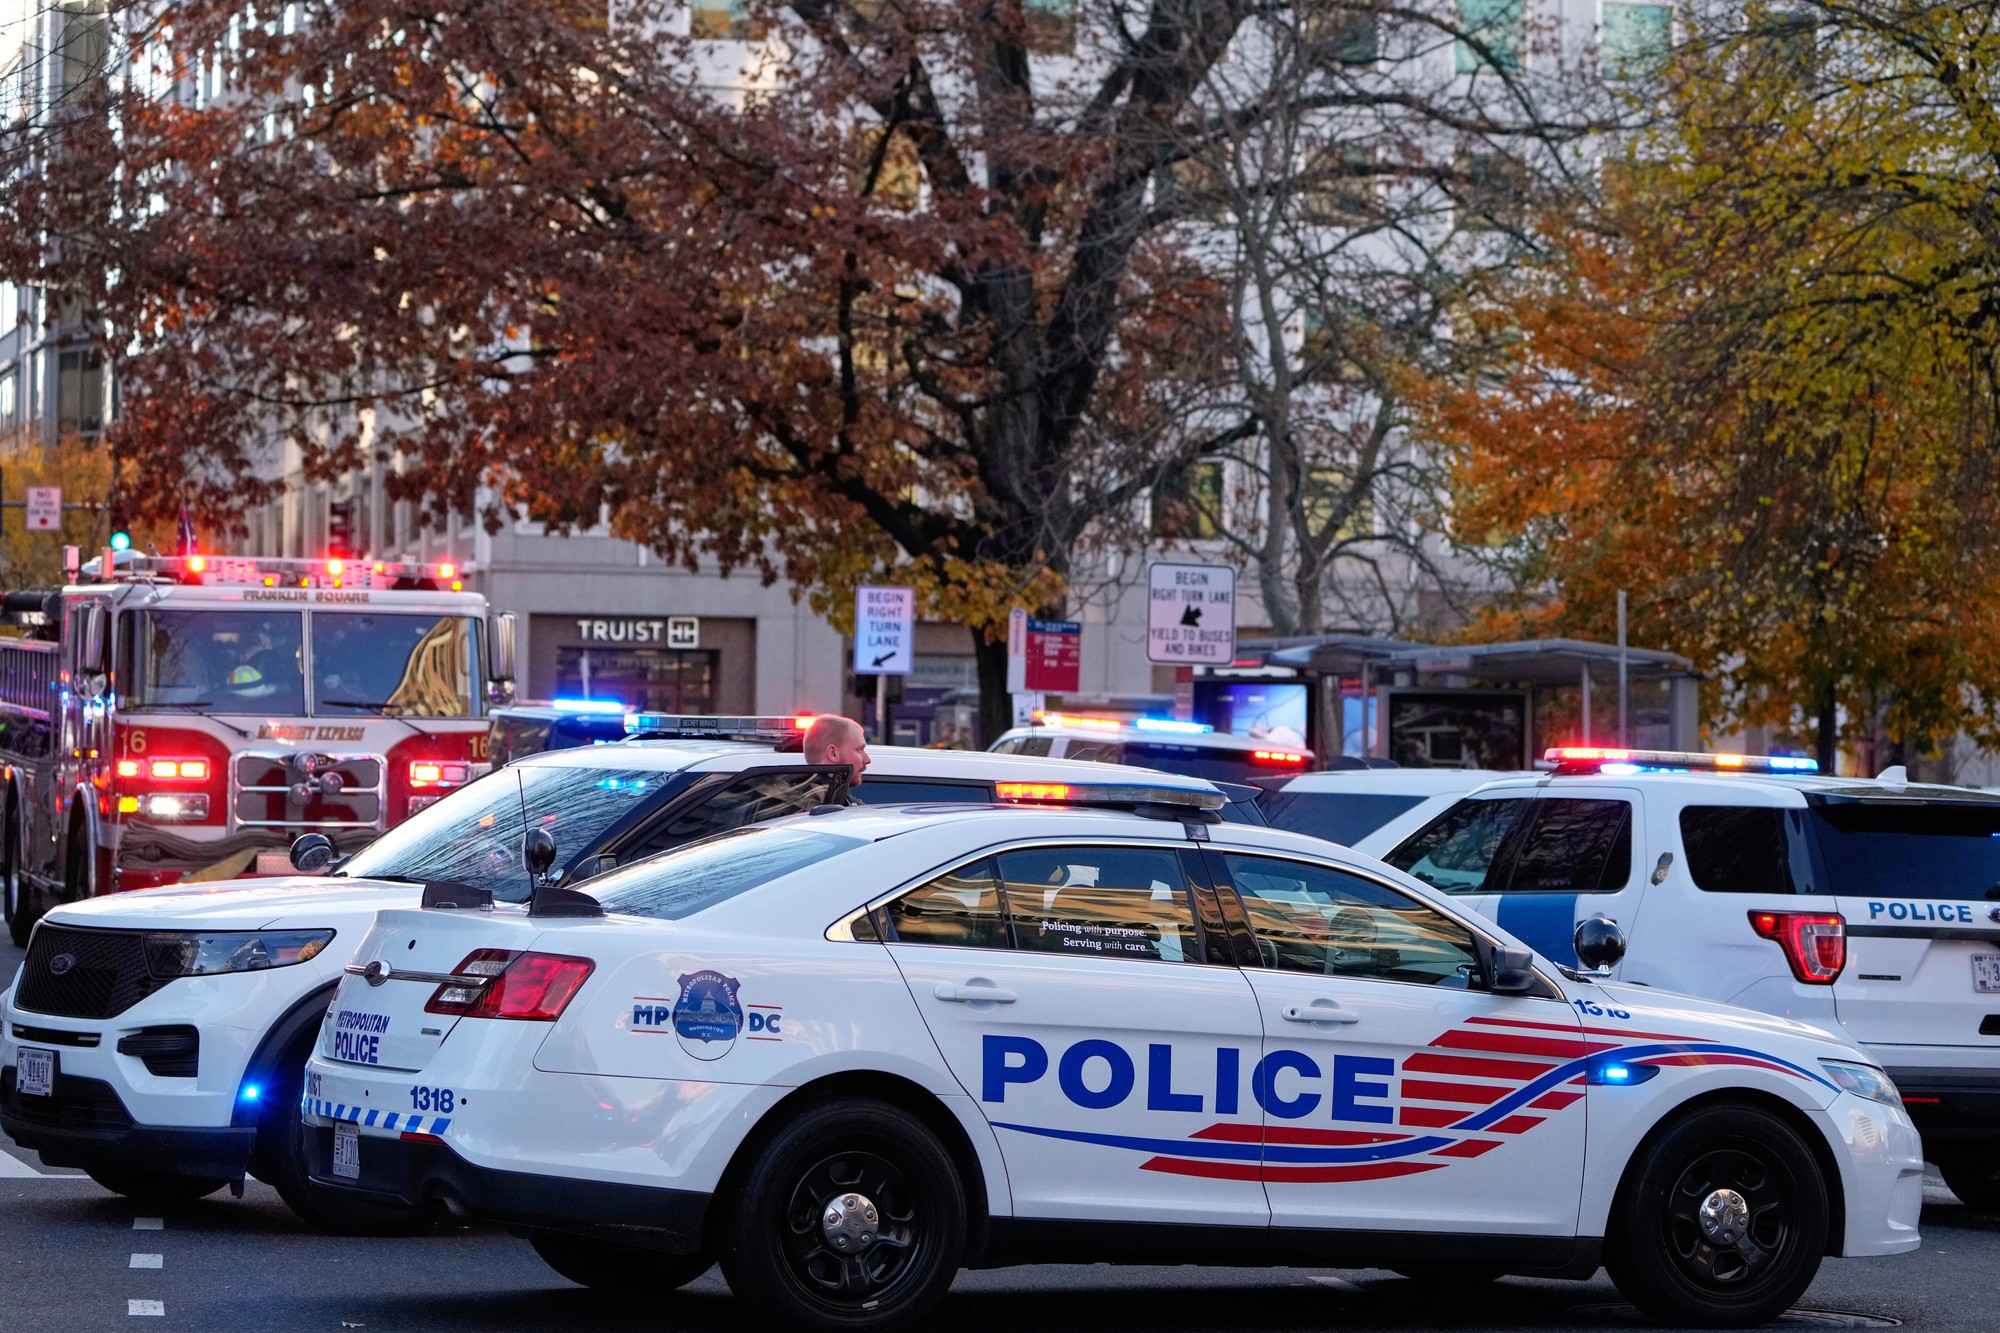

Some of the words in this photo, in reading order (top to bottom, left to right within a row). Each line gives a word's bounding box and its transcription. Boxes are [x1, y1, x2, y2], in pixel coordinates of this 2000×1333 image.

[1175, 571, 1209, 585] BEGIN
[243, 590, 308, 601] FRANKLIN
[315, 592, 370, 603] SQUARE
[867, 592, 904, 604] BEGIN
[1152, 588, 1179, 602] RIGHT
[1181, 589, 1205, 603] TURN
[1208, 590, 1231, 604] LANE
[867, 607, 902, 618] RIGHT
[577, 619, 665, 643] TRUIST
[869, 621, 902, 633] TURN
[867, 636, 901, 648] LANE
[1151, 628, 1179, 641] YIELD
[1182, 629, 1196, 642] TO
[1199, 630, 1231, 643] BUSES
[1164, 643, 1185, 656] AND
[1188, 644, 1217, 657] BIKES
[682, 719, 699, 727] SECRET
[699, 719, 717, 727] SERVICE
[120, 730, 147, 754] 16
[315, 727, 366, 742] EXPRESS
[468, 735, 488, 758] 16
[1868, 902, 1974, 923] POLICE
[1042, 920, 1082, 935] Policing
[1084, 925, 1103, 934] with
[1104, 927, 1147, 938] purpose.
[1063, 937, 1102, 950] Serving
[1104, 940, 1123, 950] with
[1124, 943, 1148, 952] care.
[682, 974, 722, 1003] METROPOLITAN
[722, 982, 736, 1007] POLICE
[335, 1010, 391, 1034] METROPOLITAN
[633, 1004, 670, 1026] MP
[748, 1012, 782, 1034] DC
[688, 1025, 725, 1034] WASHINGTON
[334, 1031, 380, 1064] POLICE
[981, 1034, 1396, 1124] POLICE
[410, 1085, 455, 1114] 1318
